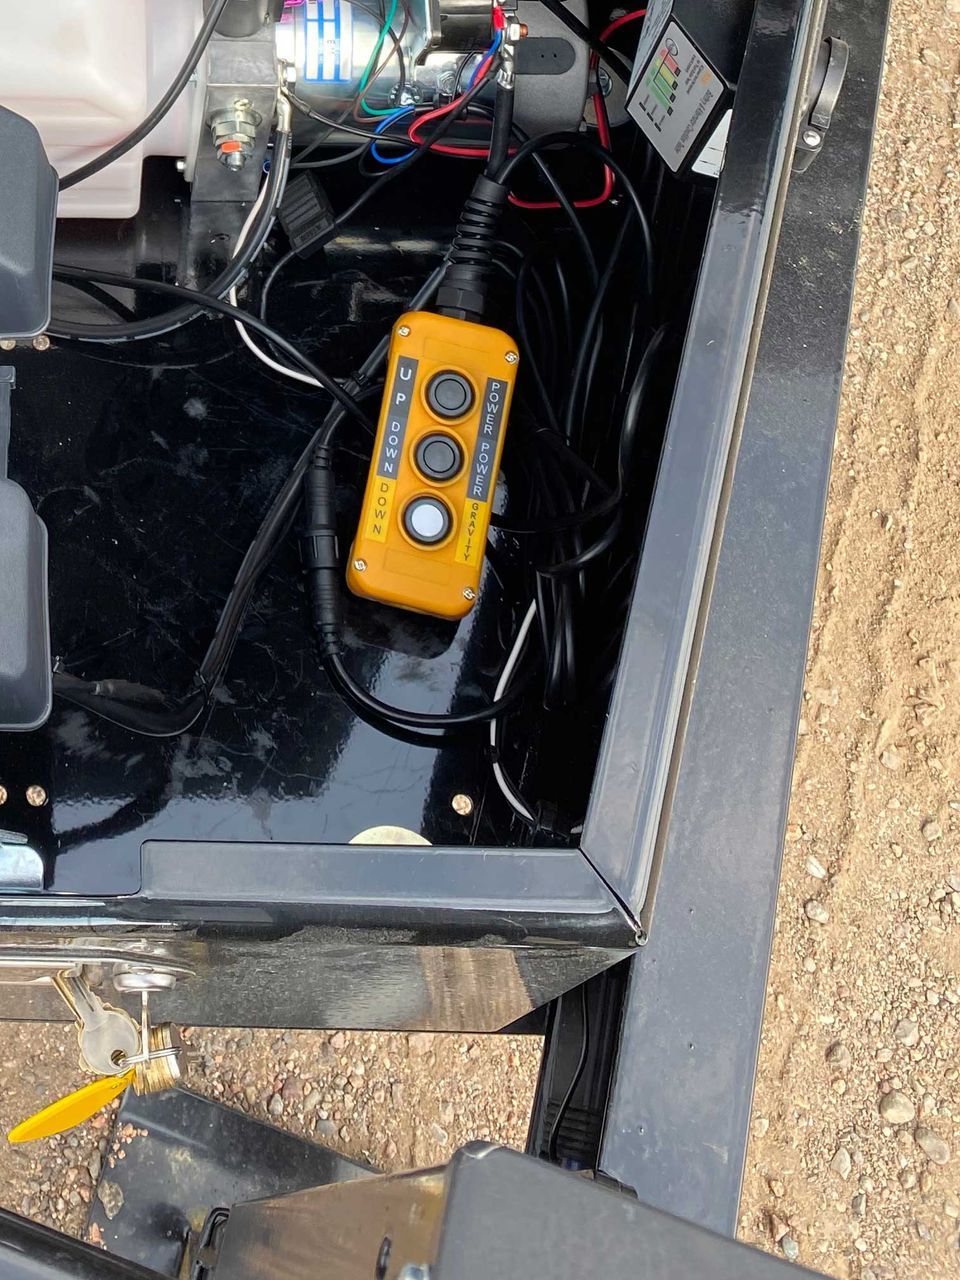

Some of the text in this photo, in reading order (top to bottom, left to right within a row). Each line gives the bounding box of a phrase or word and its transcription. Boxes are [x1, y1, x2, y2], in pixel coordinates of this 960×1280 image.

[483, 382, 501, 435] POWER
[384, 421, 401, 473] DOWN
[472, 442, 490, 497] POWER
[372, 482, 389, 535] DOWN
[463, 502, 480, 561] GRAVITY
